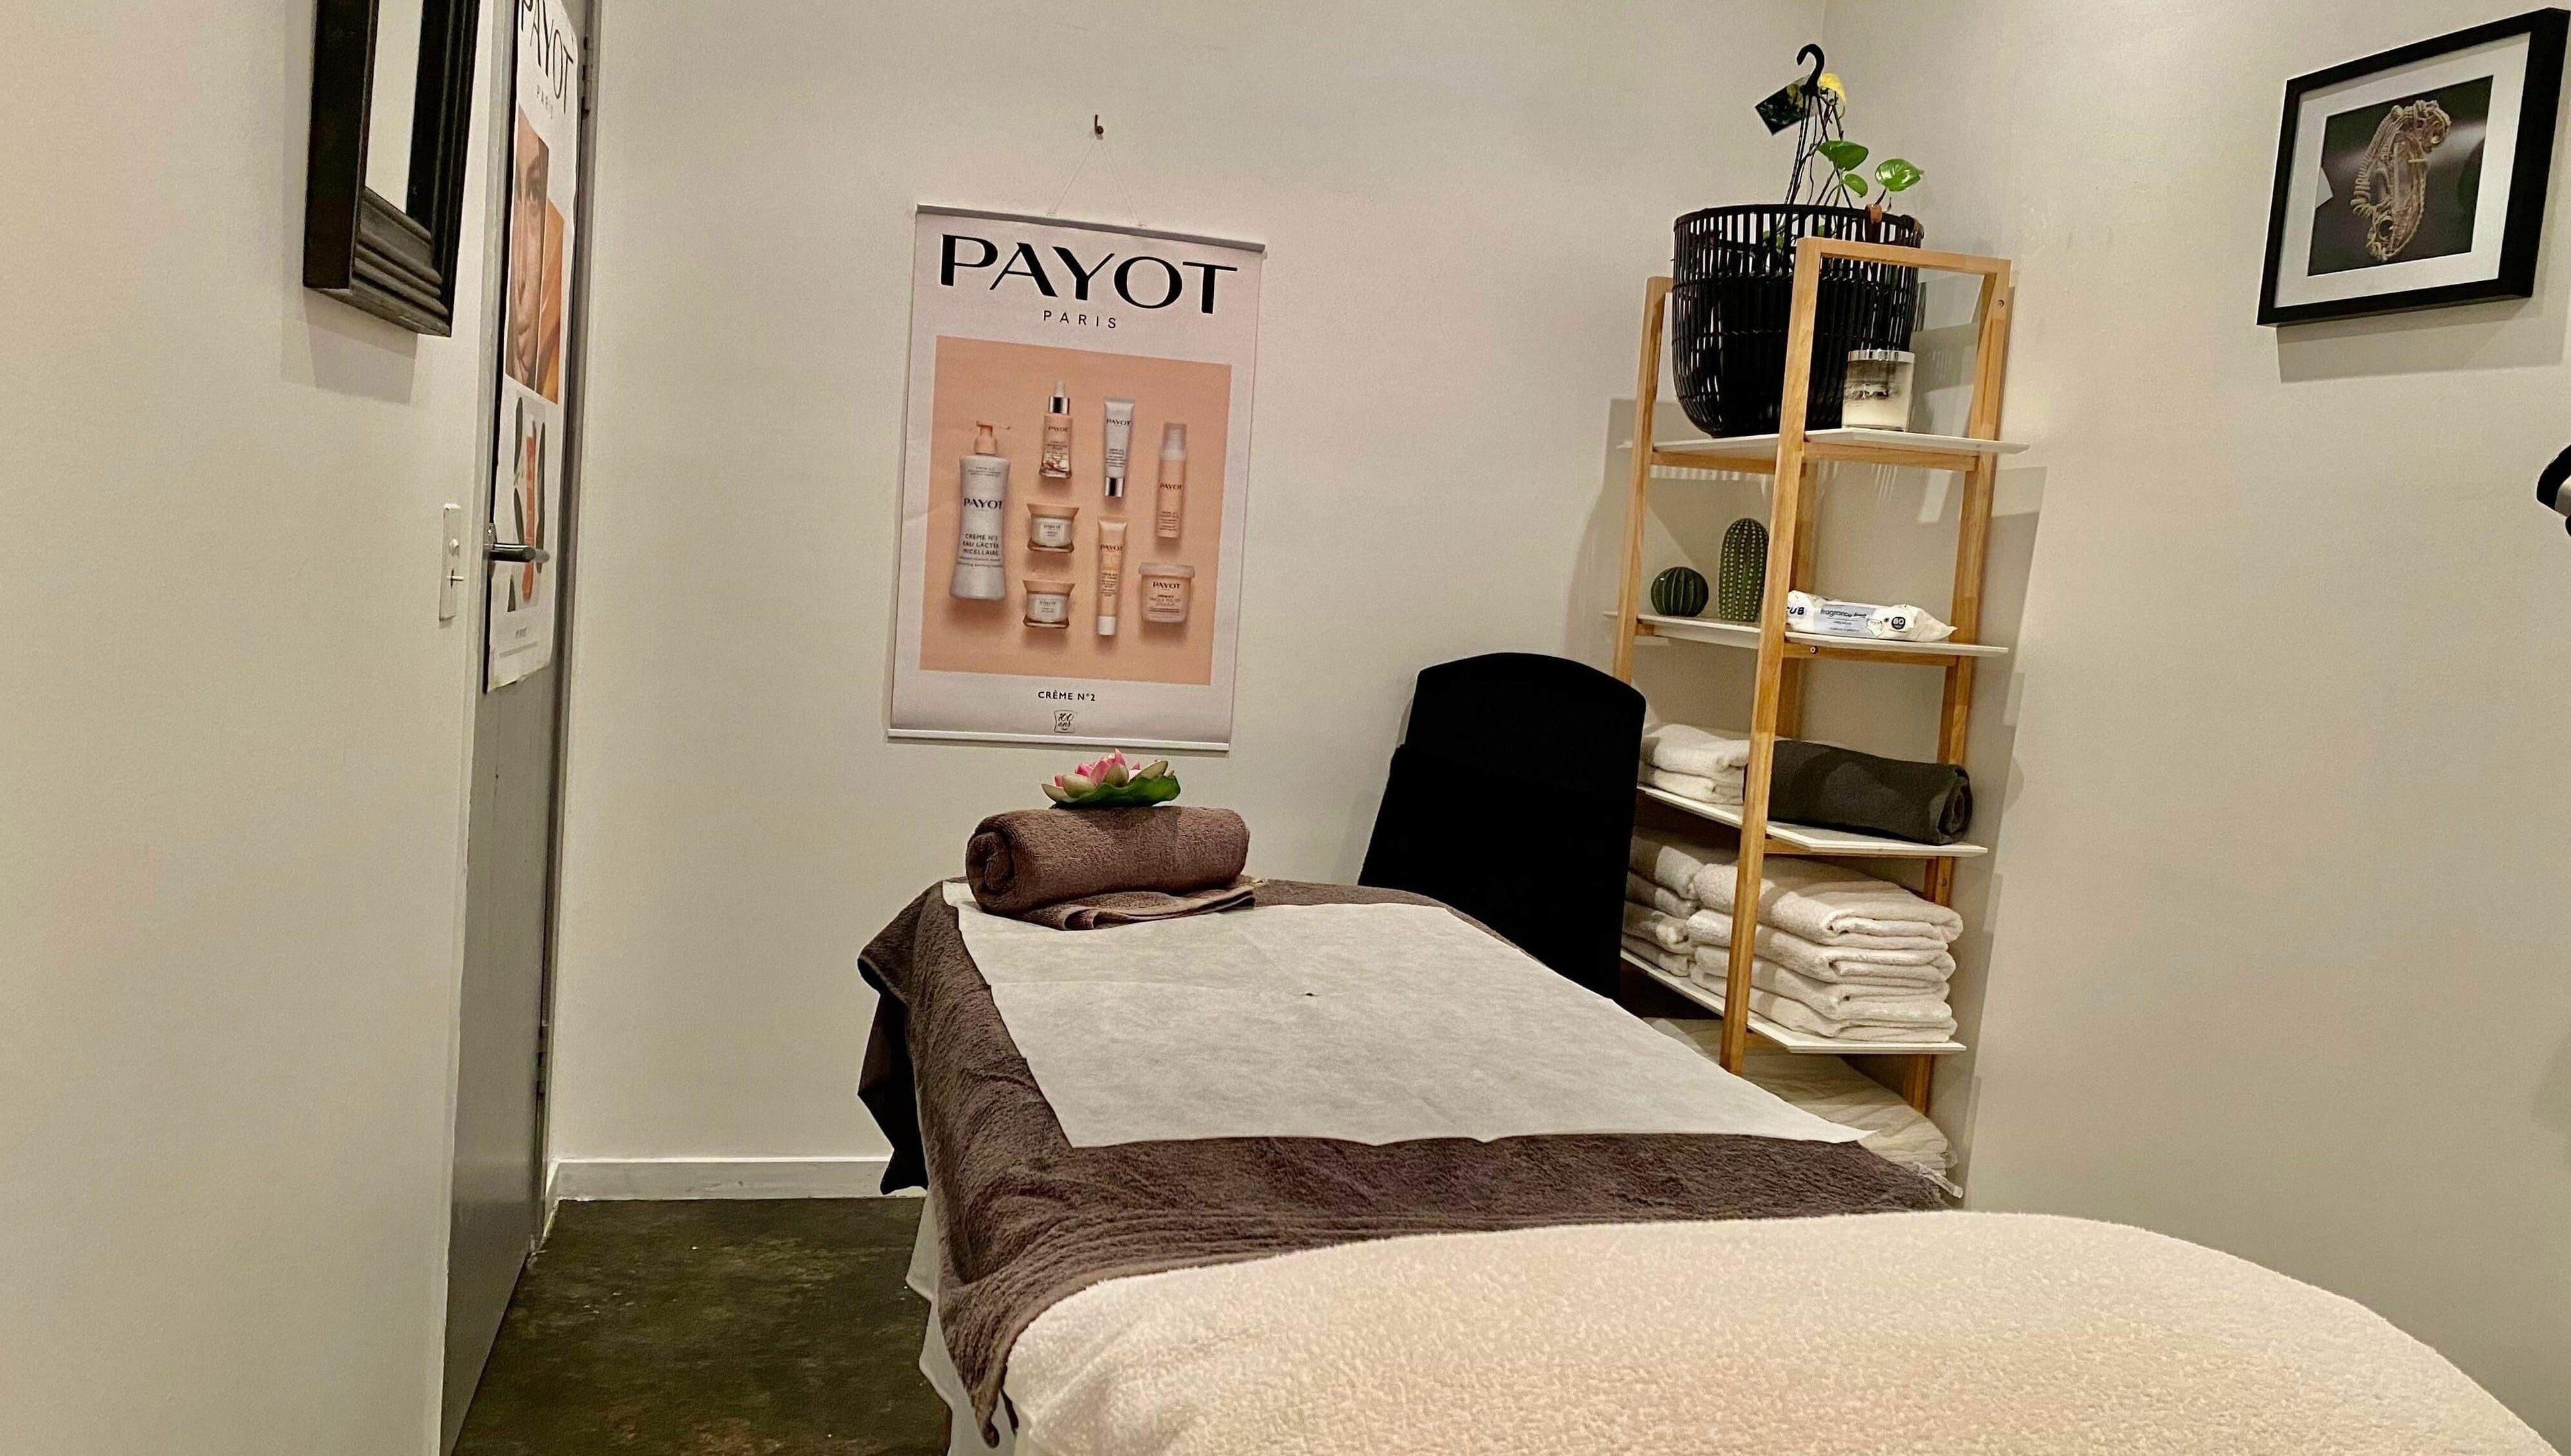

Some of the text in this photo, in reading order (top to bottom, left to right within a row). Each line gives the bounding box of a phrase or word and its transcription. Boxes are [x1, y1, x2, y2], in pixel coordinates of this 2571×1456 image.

[941, 234, 1238, 315] PAYOT
[1043, 310, 1117, 329] PARIS
[963, 497, 1003, 510] PAYOT
[1038, 690, 1073, 700] CRÈME
